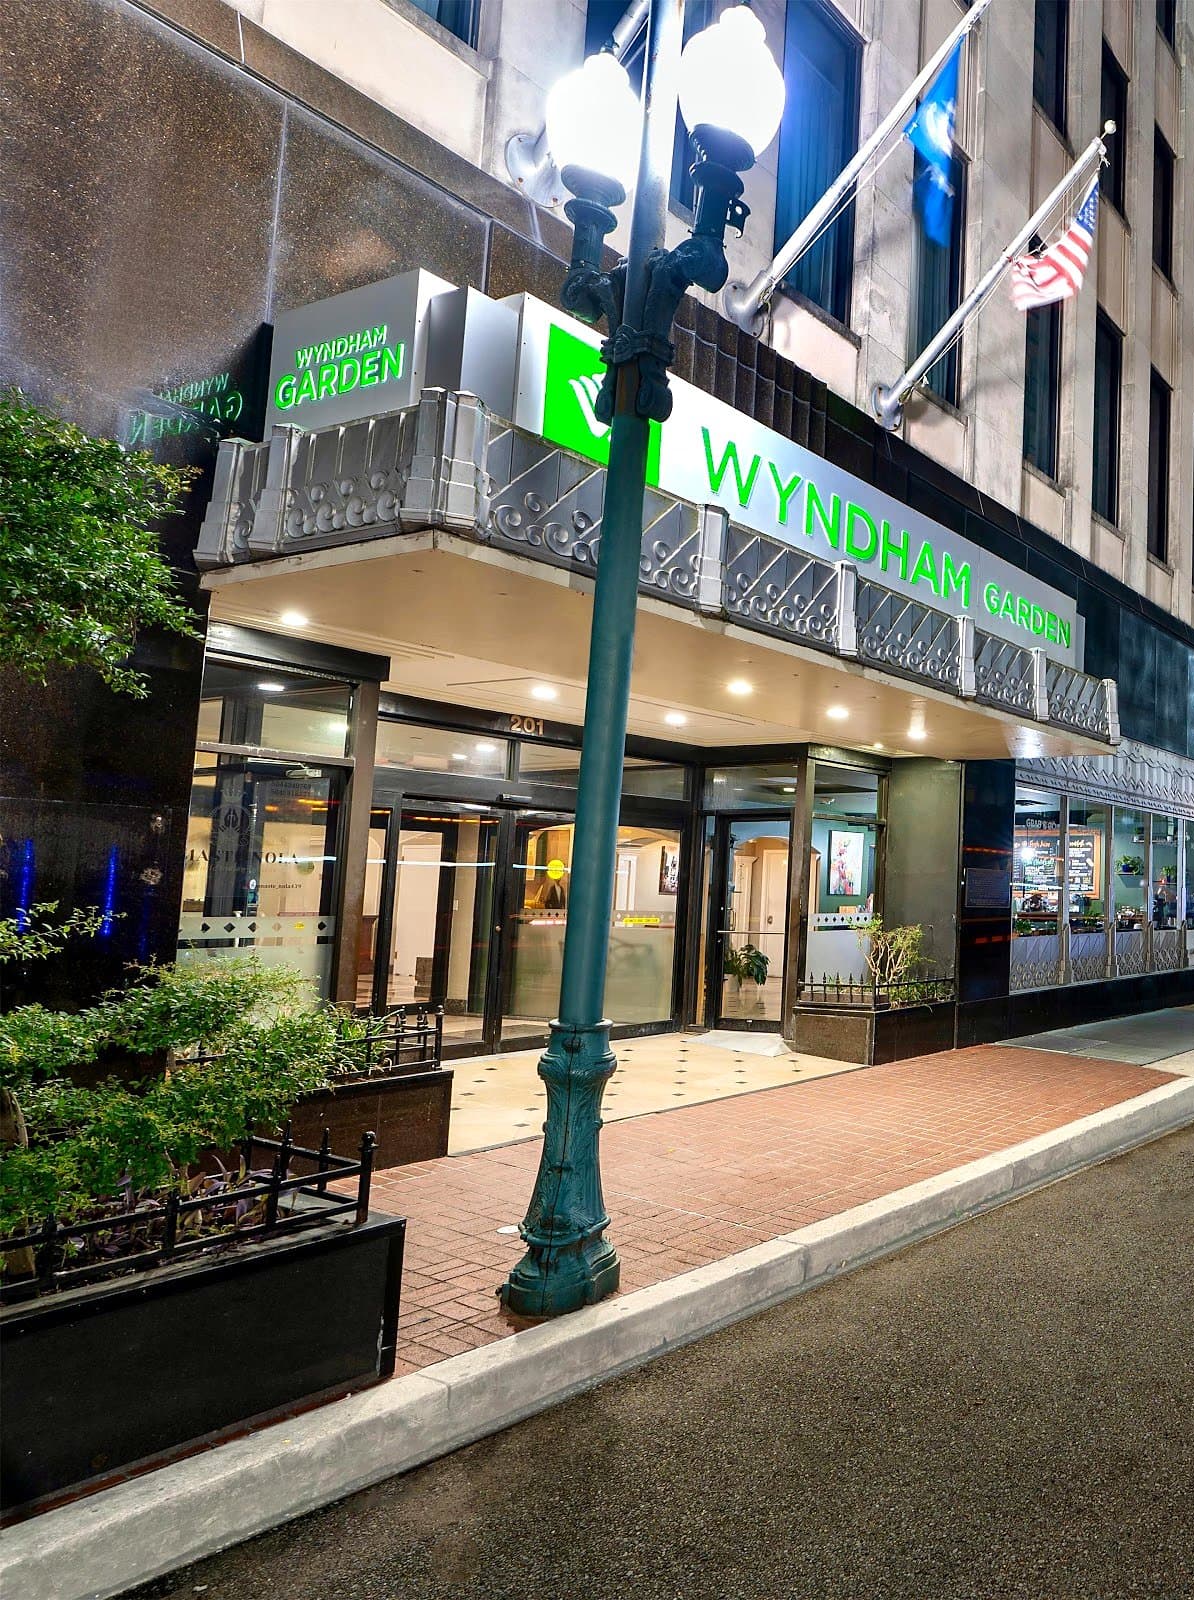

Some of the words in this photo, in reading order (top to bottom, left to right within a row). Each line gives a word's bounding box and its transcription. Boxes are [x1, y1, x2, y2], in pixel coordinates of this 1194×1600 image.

[275, 340, 405, 410] GARDEN
[295, 325, 387, 369] WYNDHAM
[701, 425, 972, 609] WYNDHAM
[983, 582, 1071, 649] GARDEN
[510, 714, 544, 737] 201
